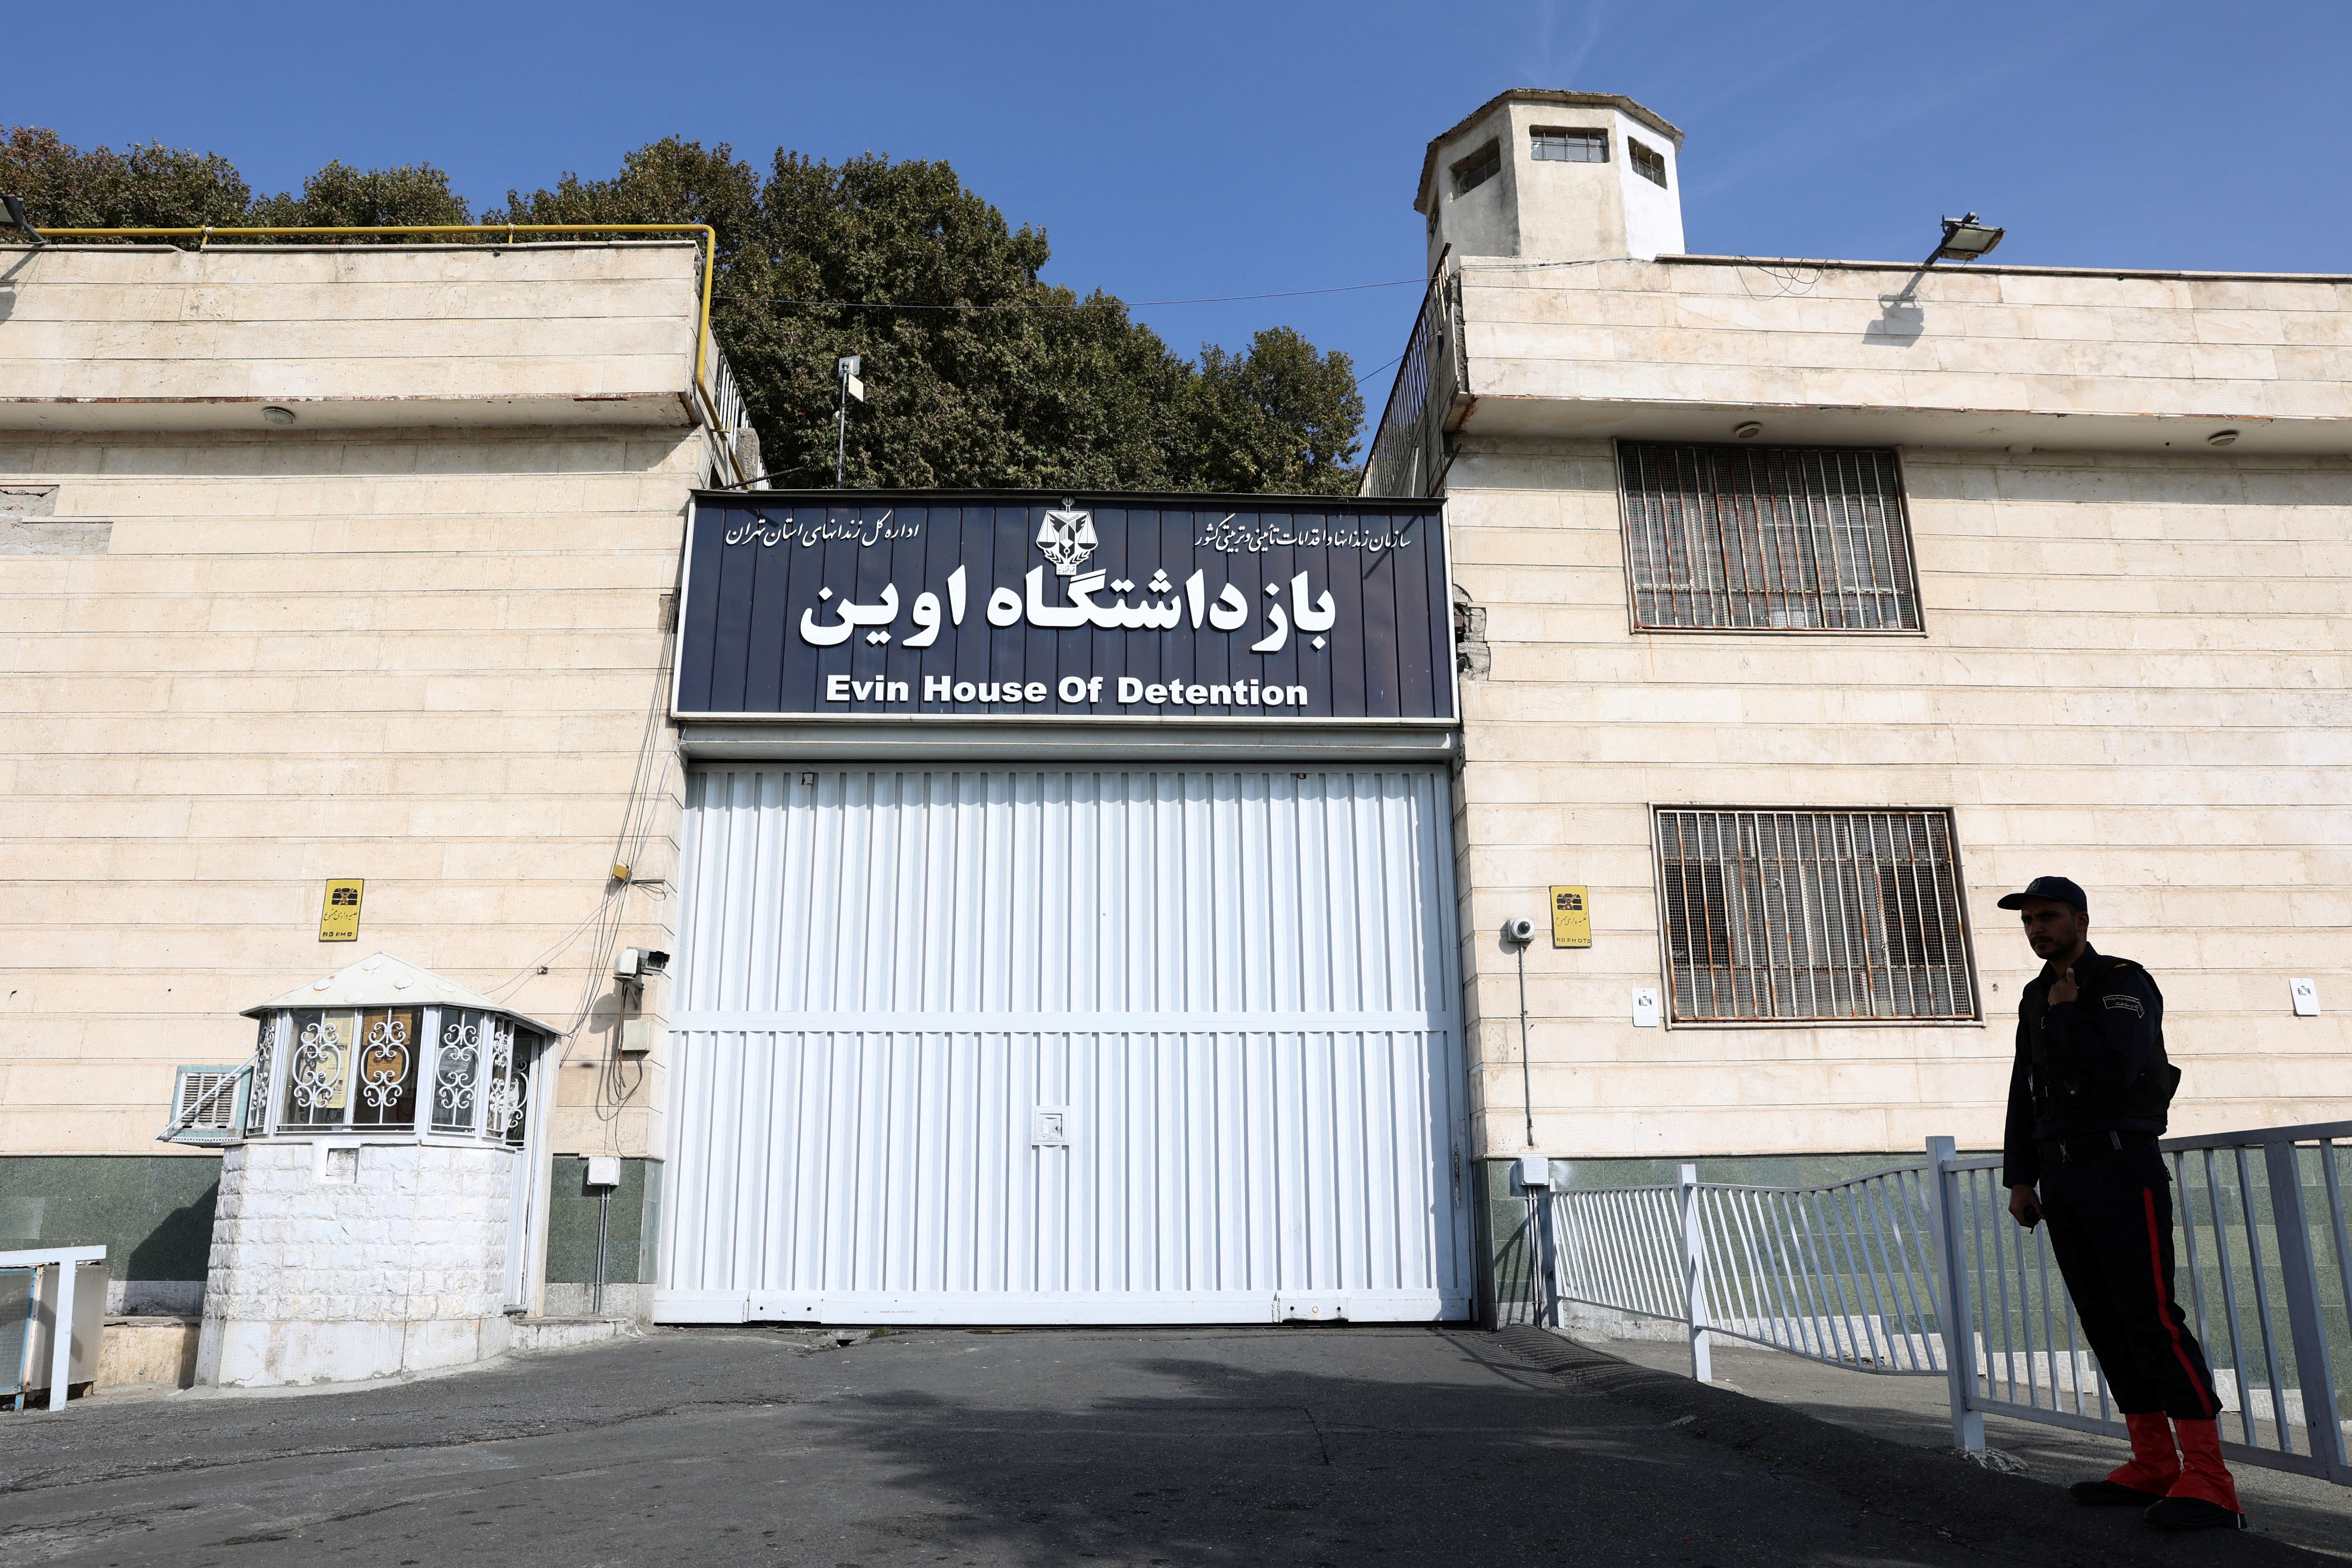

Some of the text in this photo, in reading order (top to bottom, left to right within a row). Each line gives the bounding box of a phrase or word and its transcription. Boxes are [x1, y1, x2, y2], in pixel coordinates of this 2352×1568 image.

[726, 510, 919, 547] اداره کل زندانهای استان تهران
[1194, 513, 1235, 546] کشور
[1215, 525, 1245, 552] تربیتی
[1276, 529, 1326, 545] اقدامات
[1334, 529, 1369, 547] زندانها
[1369, 530, 1411, 551] سازمان
[800, 565, 1336, 652] بازداشتگاه اوین
[827, 674, 1308, 705] Evin House Of Detention
